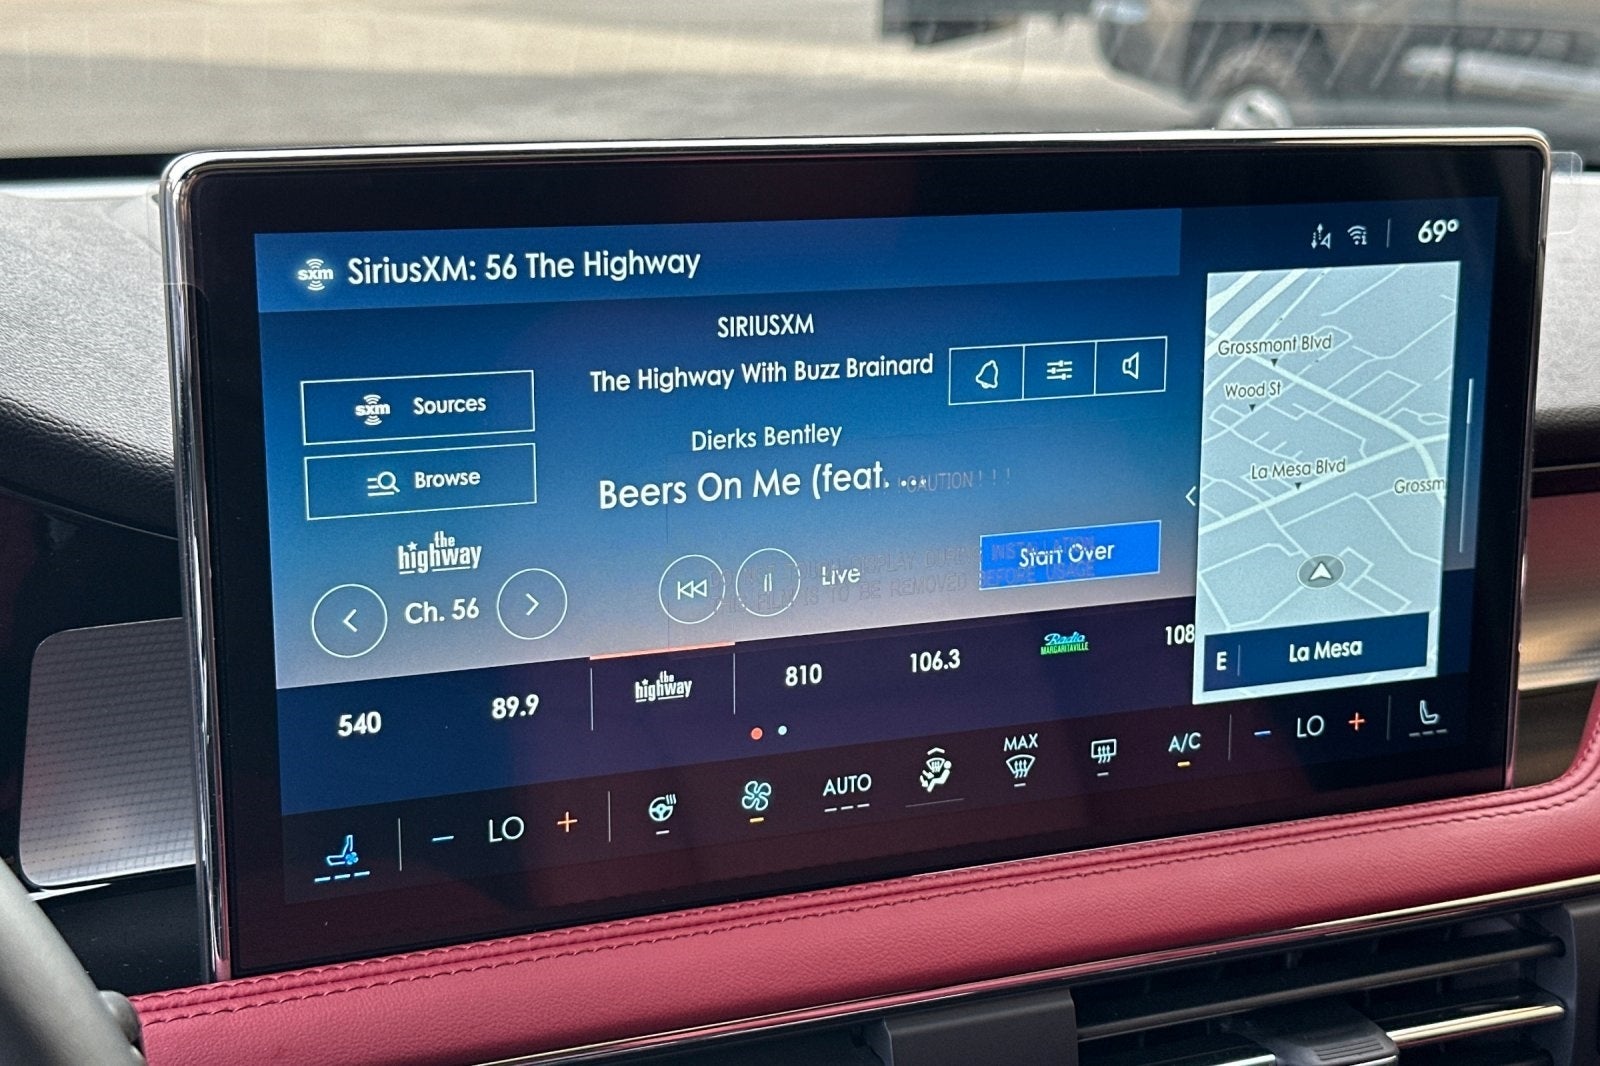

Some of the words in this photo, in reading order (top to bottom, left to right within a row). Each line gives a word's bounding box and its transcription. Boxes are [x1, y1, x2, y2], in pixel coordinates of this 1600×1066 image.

[347, 255, 477, 284] SiriusXM:
[485, 253, 517, 281] 56
[526, 253, 575, 279] The
[583, 250, 701, 281] Highway
[717, 313, 814, 337] SIRIUSXM
[1218, 337, 1296, 356] Grossmont
[1301, 335, 1332, 351] Blvd
[590, 371, 630, 392] The
[638, 365, 735, 393] Highway
[741, 361, 787, 384] With
[794, 359, 840, 381] Buzz
[846, 353, 933, 378] Brainard
[1225, 384, 1264, 398] Wood
[1267, 382, 1281, 395] St
[413, 396, 486, 415] Sources
[692, 428, 757, 451] Dierks
[765, 423, 843, 446] Bentley
[415, 470, 481, 489] Browse
[1251, 465, 1268, 480] La
[1272, 462, 1311, 478] Mesa
[1316, 459, 1346, 474] Blvd
[600, 481, 687, 509] Beers
[698, 472, 742, 501] On
[753, 469, 800, 497] Me
[813, 461, 889, 499] (feat.
[906, 470, 974, 493] CAUTION
[434, 531, 455, 547] the
[398, 543, 482, 573] highway
[851, 553, 914, 575] DISPLAY
[1018, 543, 1063, 568] Start
[1067, 541, 1116, 564] Over
[821, 566, 861, 587] Live
[859, 580, 881, 599] BE
[891, 572, 967, 598] REMOVED
[405, 602, 445, 624] Ch.
[452, 598, 479, 620] 56
[1040, 642, 1089, 655] MARGARITAVILLE
[1044, 632, 1086, 645] Radio
[910, 648, 961, 673] 106.3
[1216, 652, 1227, 670] E
[1289, 644, 1309, 662] La
[1314, 640, 1362, 659] Mesa
[660, 671, 674, 684] the
[785, 664, 823, 686] 810
[635, 678, 693, 702] highway
[492, 694, 539, 719] 89.9
[338, 712, 382, 737] 540
[1297, 716, 1324, 737] LO
[1004, 733, 1038, 751] MAX
[1168, 731, 1201, 753] A/C
[823, 773, 872, 796] AUTO
[488, 816, 525, 843] LO
